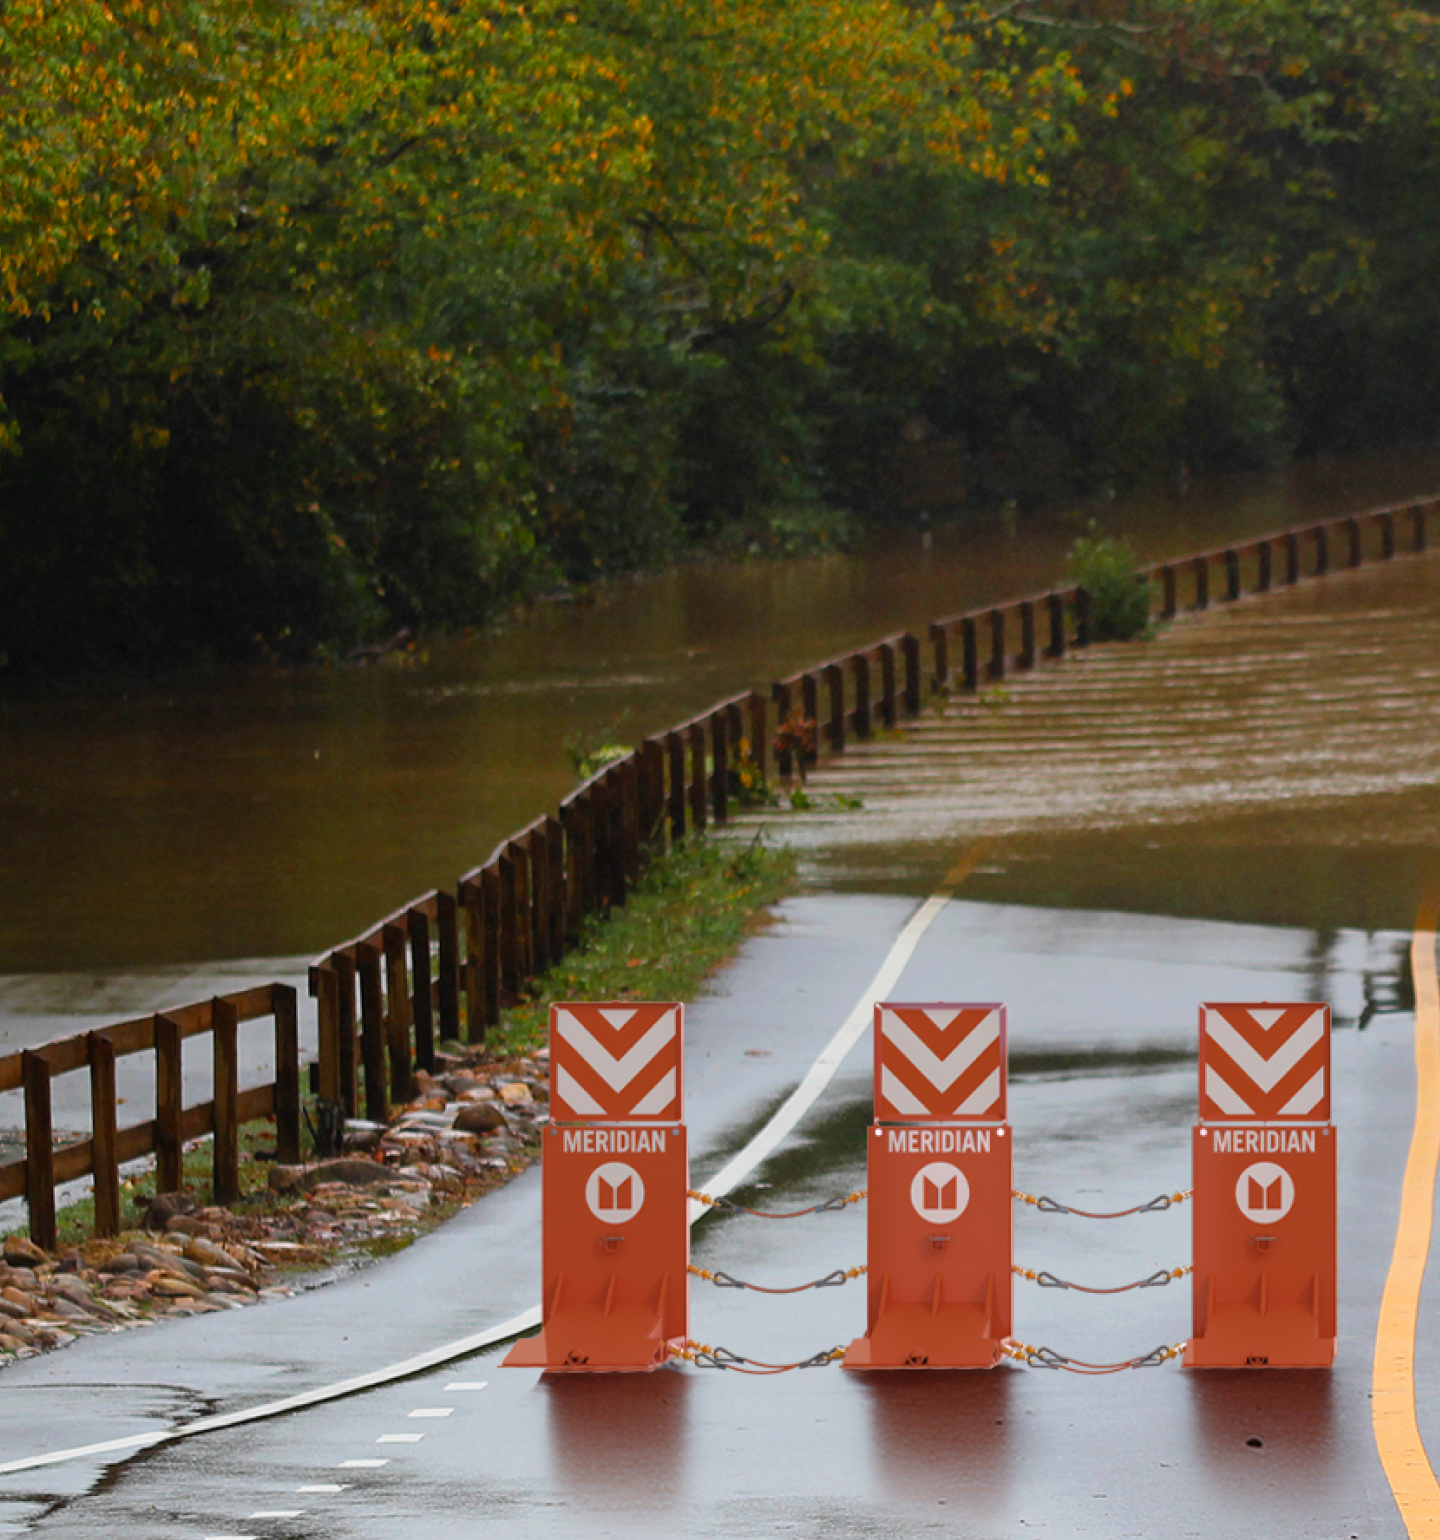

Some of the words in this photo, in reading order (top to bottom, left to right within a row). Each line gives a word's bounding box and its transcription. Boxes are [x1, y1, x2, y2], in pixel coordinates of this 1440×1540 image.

[563, 1129, 666, 1153] MERIDIAN
[888, 1129, 991, 1153] MERIDIAN
[1213, 1129, 1316, 1153] MERIDIAN
